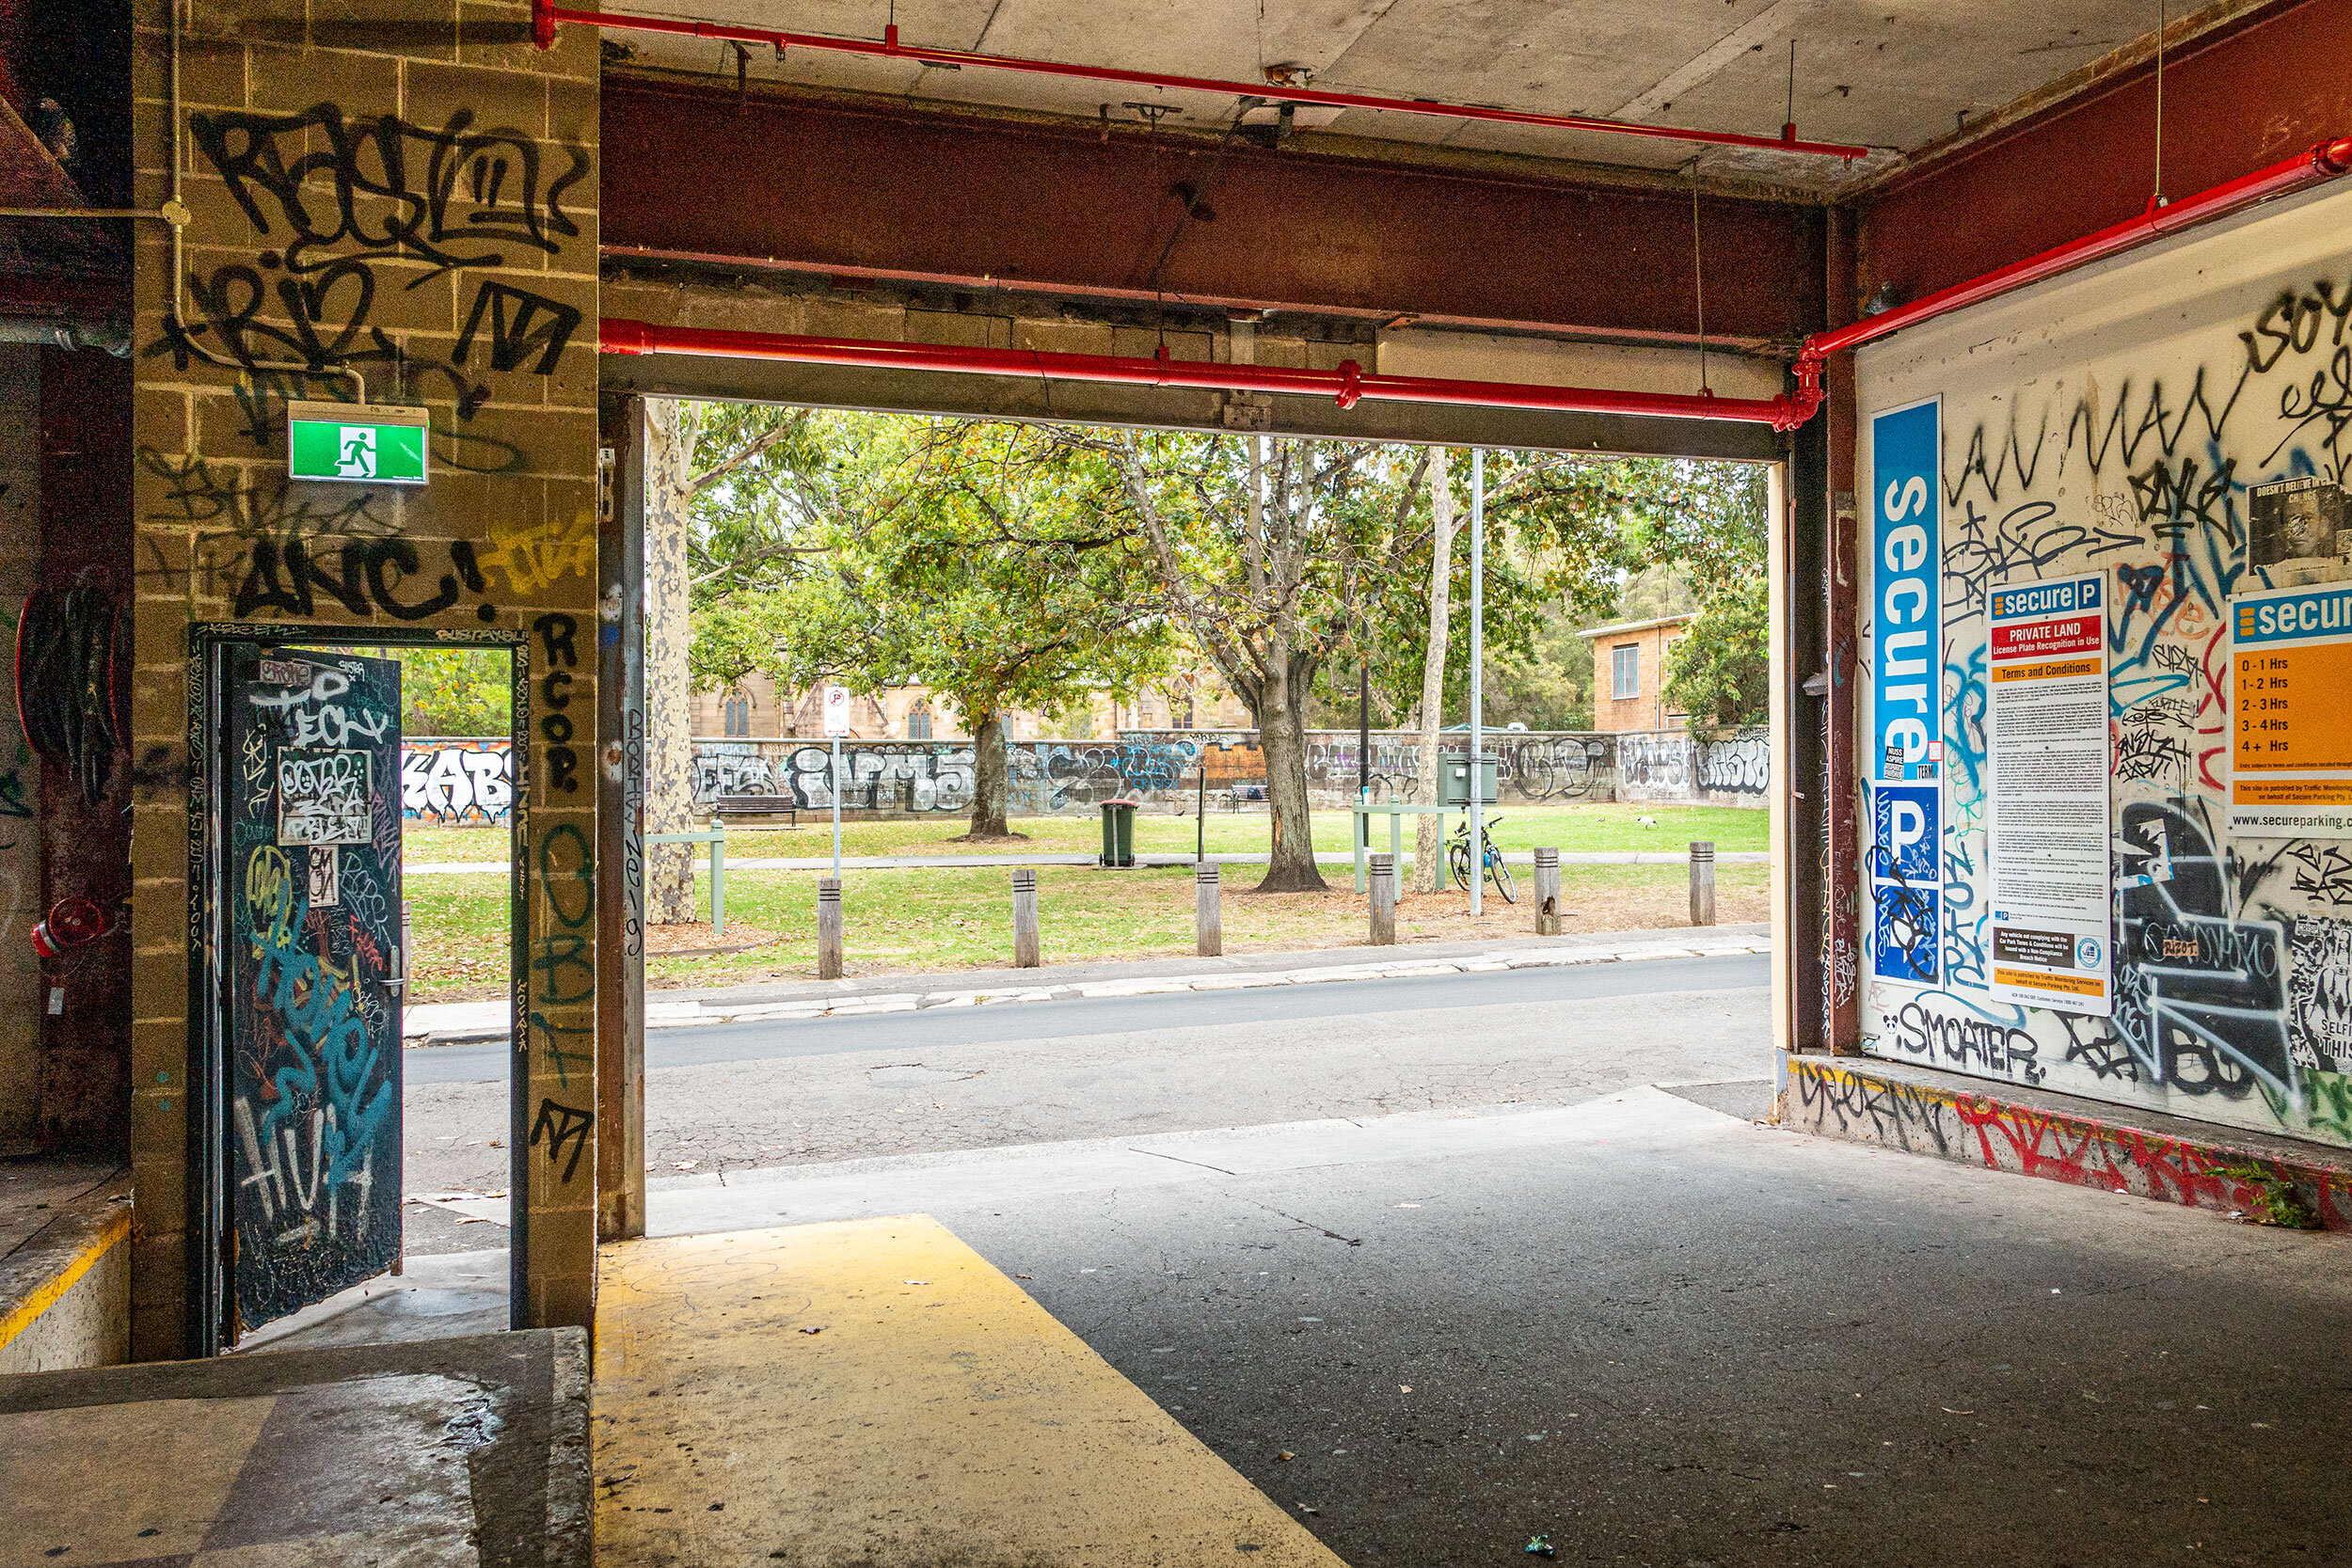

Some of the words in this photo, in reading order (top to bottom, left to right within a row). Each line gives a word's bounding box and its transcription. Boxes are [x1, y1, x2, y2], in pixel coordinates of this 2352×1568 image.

[2256, 483, 2284, 498] DOESN'T
[2285, 478, 2312, 492] BELIEVE
[2005, 586, 2073, 614] secure
[2083, 583, 2096, 605] P
[1884, 477, 1929, 764] secure
[2010, 626, 2051, 642] PRIVATE
[2054, 622, 2081, 638] LAND
[1993, 645, 2017, 656] License
[2018, 643, 2035, 653] Plate
[2036, 638, 2076, 651] Recognition
[2077, 637, 2085, 646] in
[2086, 636, 2100, 645] Use
[2002, 669, 2026, 679] Terms
[2027, 666, 2043, 677] and
[2045, 662, 2091, 675] Conditions
[2242, 659, 2249, 672] 0
[2260, 658, 2265, 671] 1
[2269, 657, 2288, 670] Hrs
[2242, 678, 2247, 690] 1
[2256, 677, 2265, 689] 2
[2269, 676, 2288, 689] Hrs
[2242, 699, 2249, 711] 2
[2260, 698, 2267, 710] 3
[2269, 697, 2288, 710] Hrs
[2242, 720, 2249, 732] 3
[2259, 719, 2268, 731] 4
[2269, 719, 2288, 731] Hrs
[2242, 740, 2249, 752] 4
[2269, 739, 2289, 752] Hrs
[2233, 814, 2352, 831] www.secureparking.c
[1891, 800, 1926, 865] P
[2017, 971, 2035, 979] patrolled
[2054, 975, 2075, 985] Monitoring
[2076, 978, 2094, 987] Services
[2046, 982, 2063, 990] Parking
